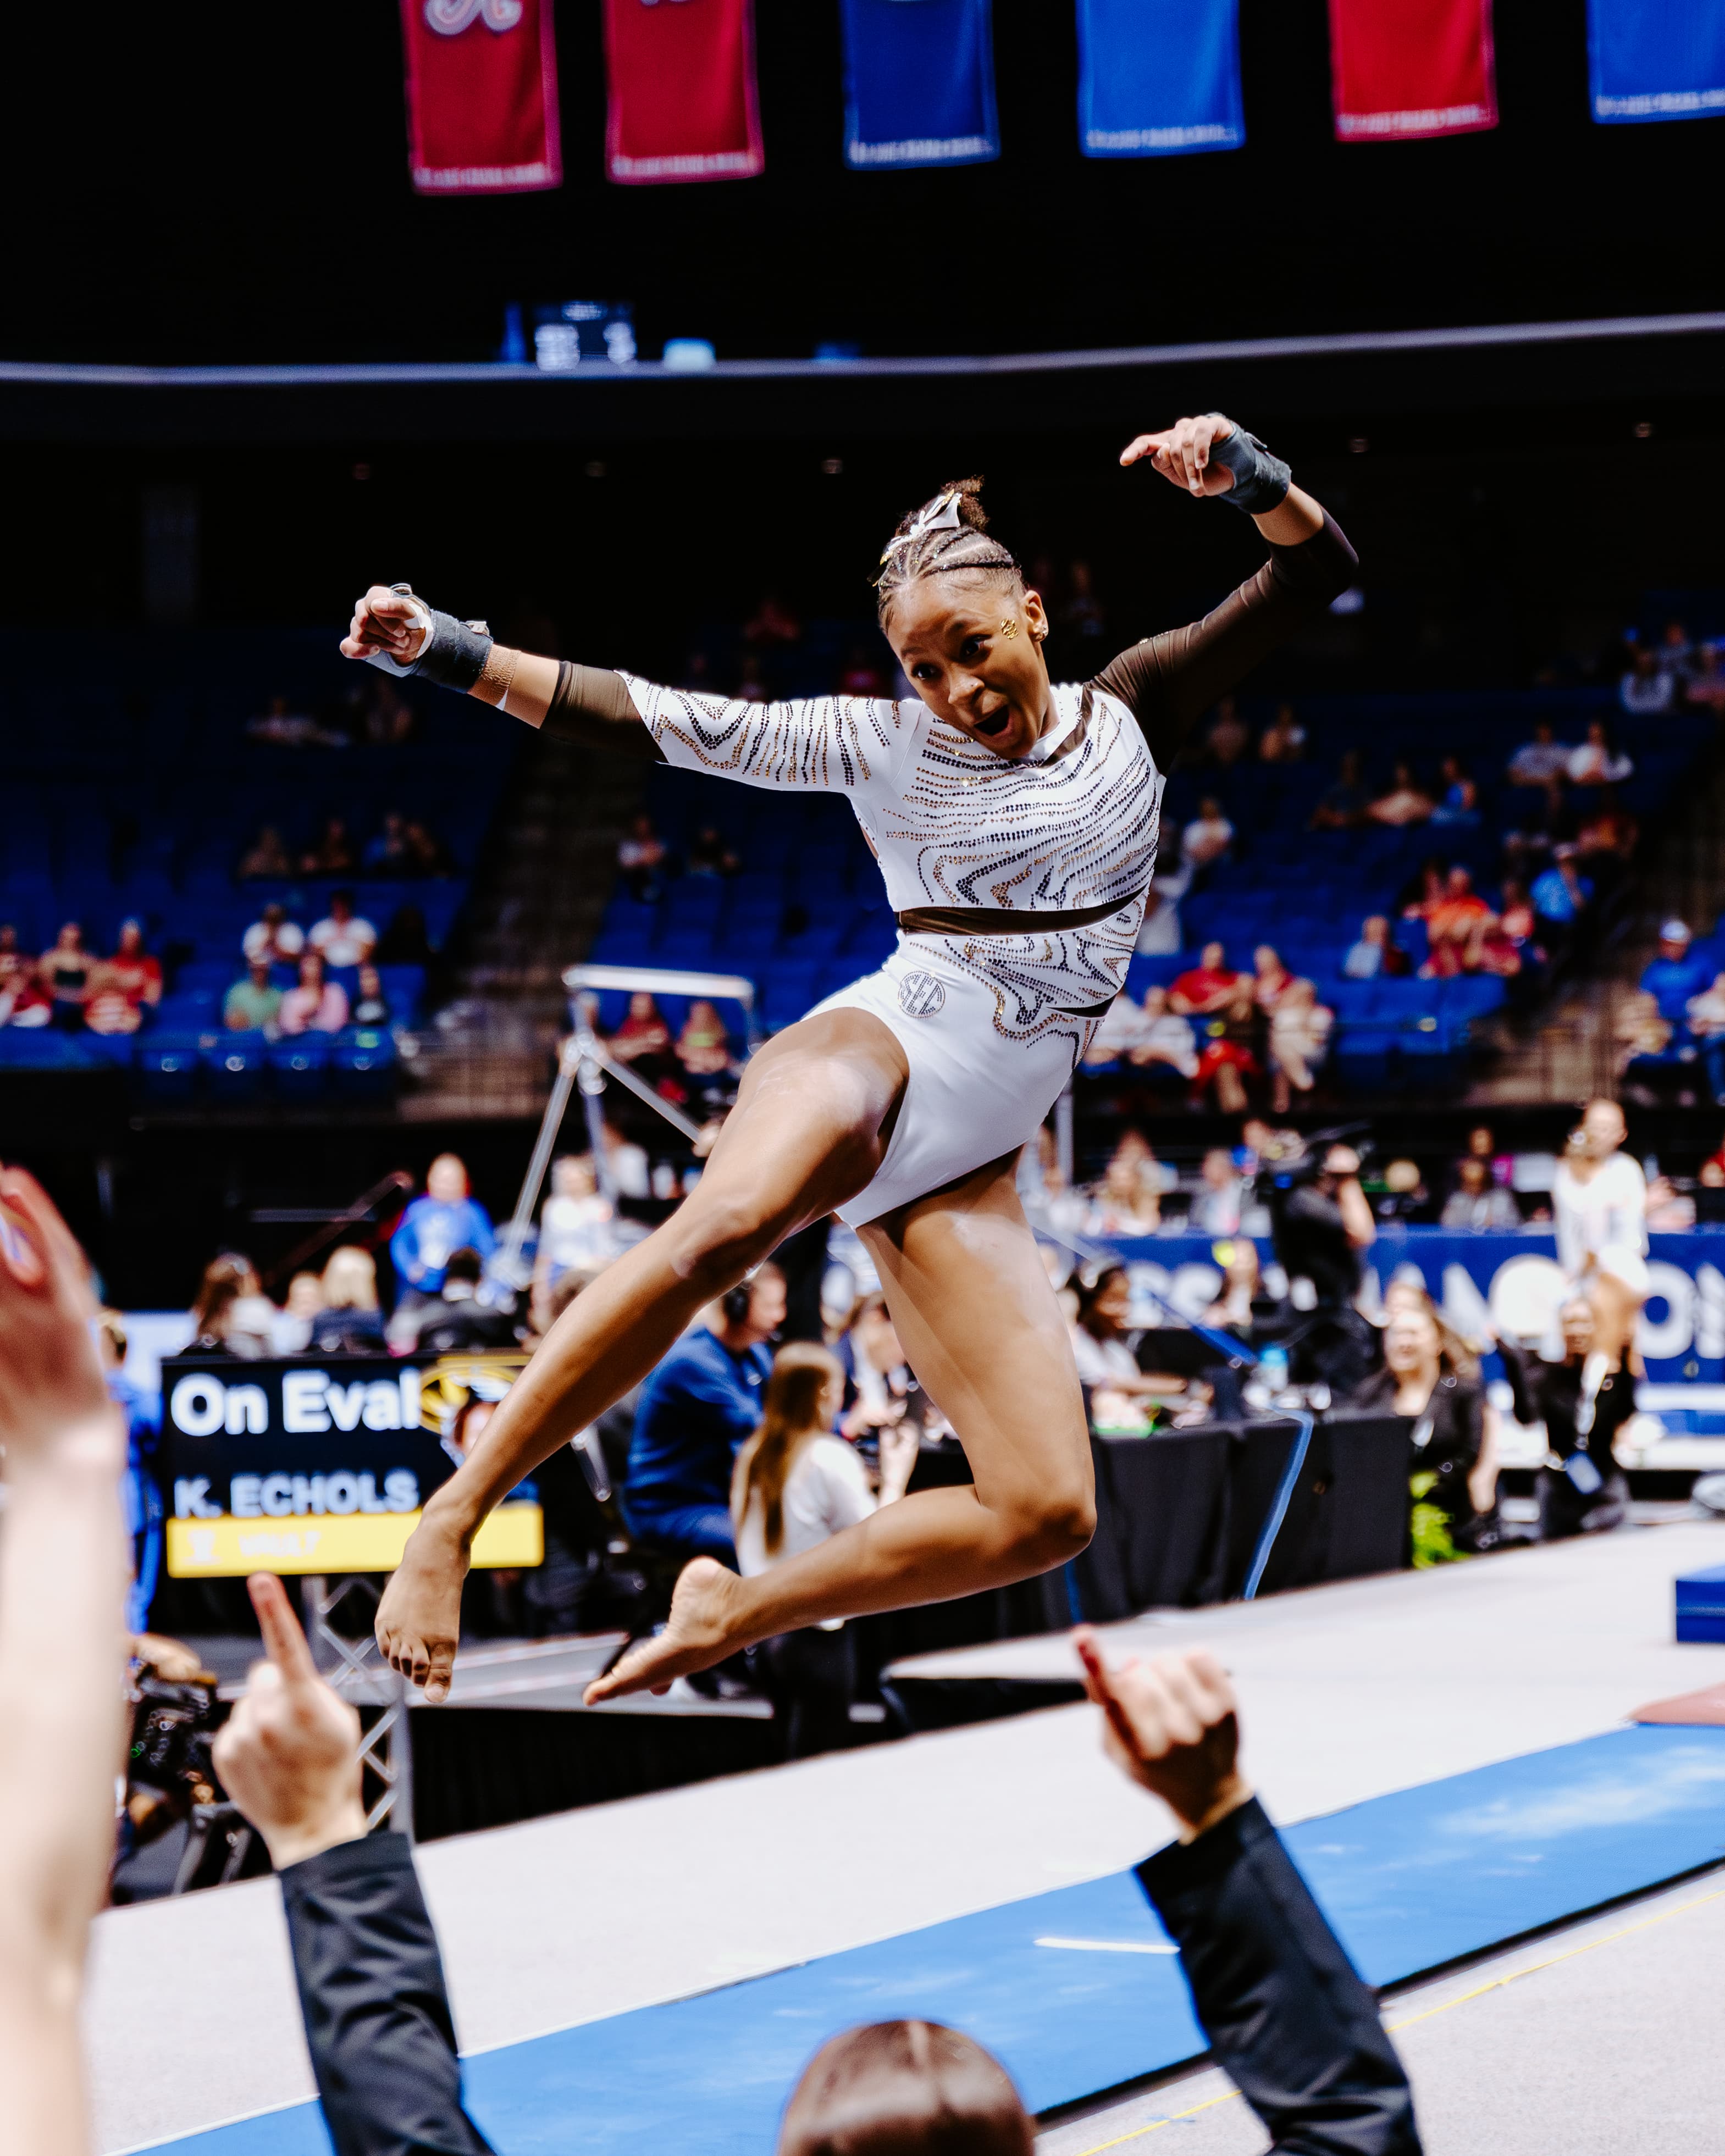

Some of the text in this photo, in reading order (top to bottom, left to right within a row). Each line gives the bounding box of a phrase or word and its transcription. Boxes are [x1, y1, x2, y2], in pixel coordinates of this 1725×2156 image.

[172, 1367, 421, 1435] On Eval
[174, 1471, 419, 1517] K. ECHOLS
